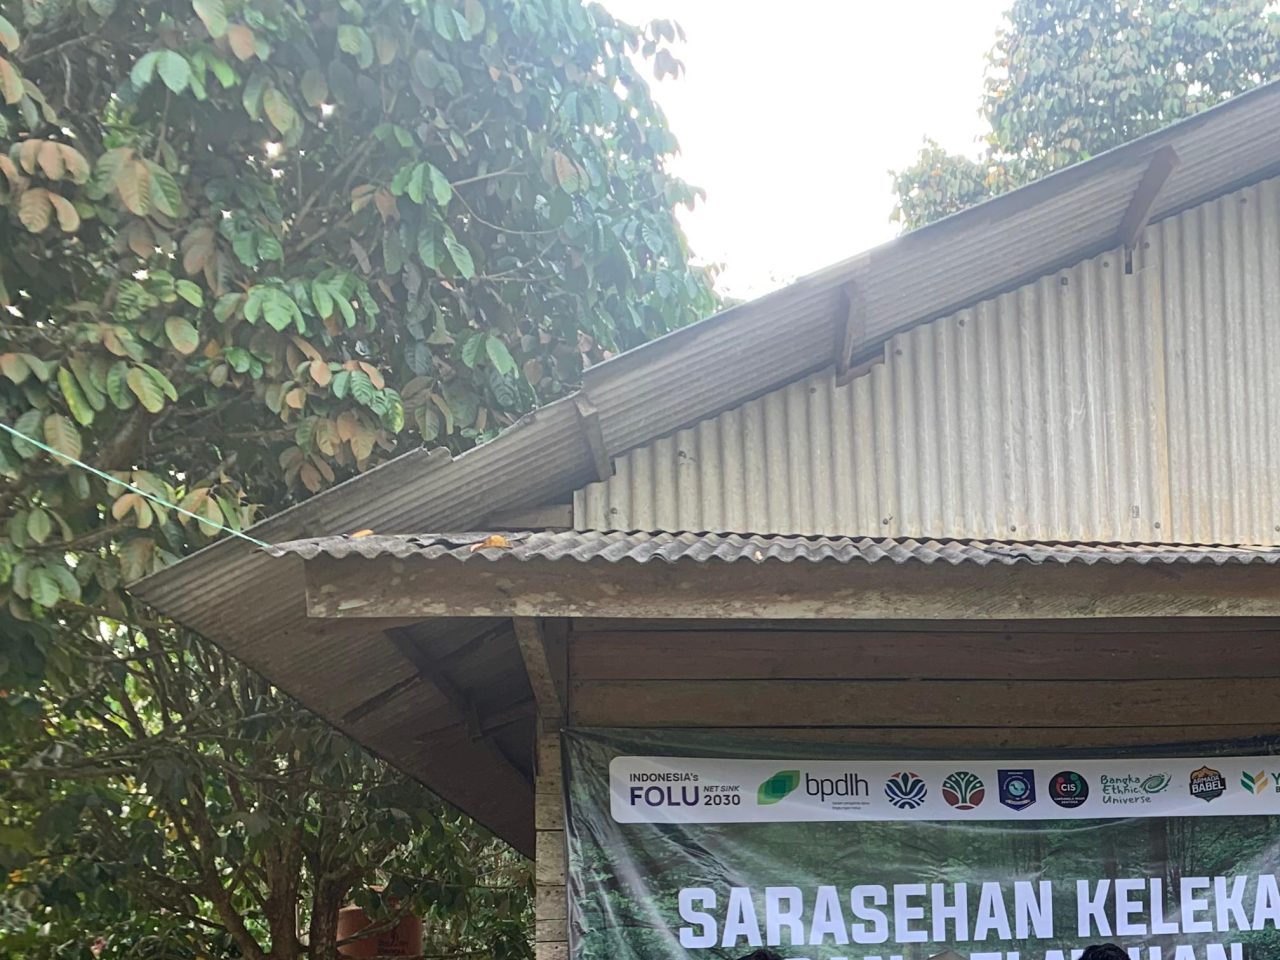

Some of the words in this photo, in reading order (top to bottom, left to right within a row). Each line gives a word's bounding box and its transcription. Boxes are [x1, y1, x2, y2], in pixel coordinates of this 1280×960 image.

[629, 772, 699, 782] INDONESIA's
[1100, 774, 1141, 786] Bangka
[703, 785, 721, 793] NET
[720, 785, 740, 793] SINK
[805, 772, 869, 802] bpdlh
[1060, 783, 1077, 792] CIS
[1192, 780, 1225, 794] BABEL
[630, 785, 700, 807] FOLU
[703, 794, 741, 806] 2030
[1102, 795, 1152, 804] Universe
[678, 880, 1053, 949] SARASEHAN
